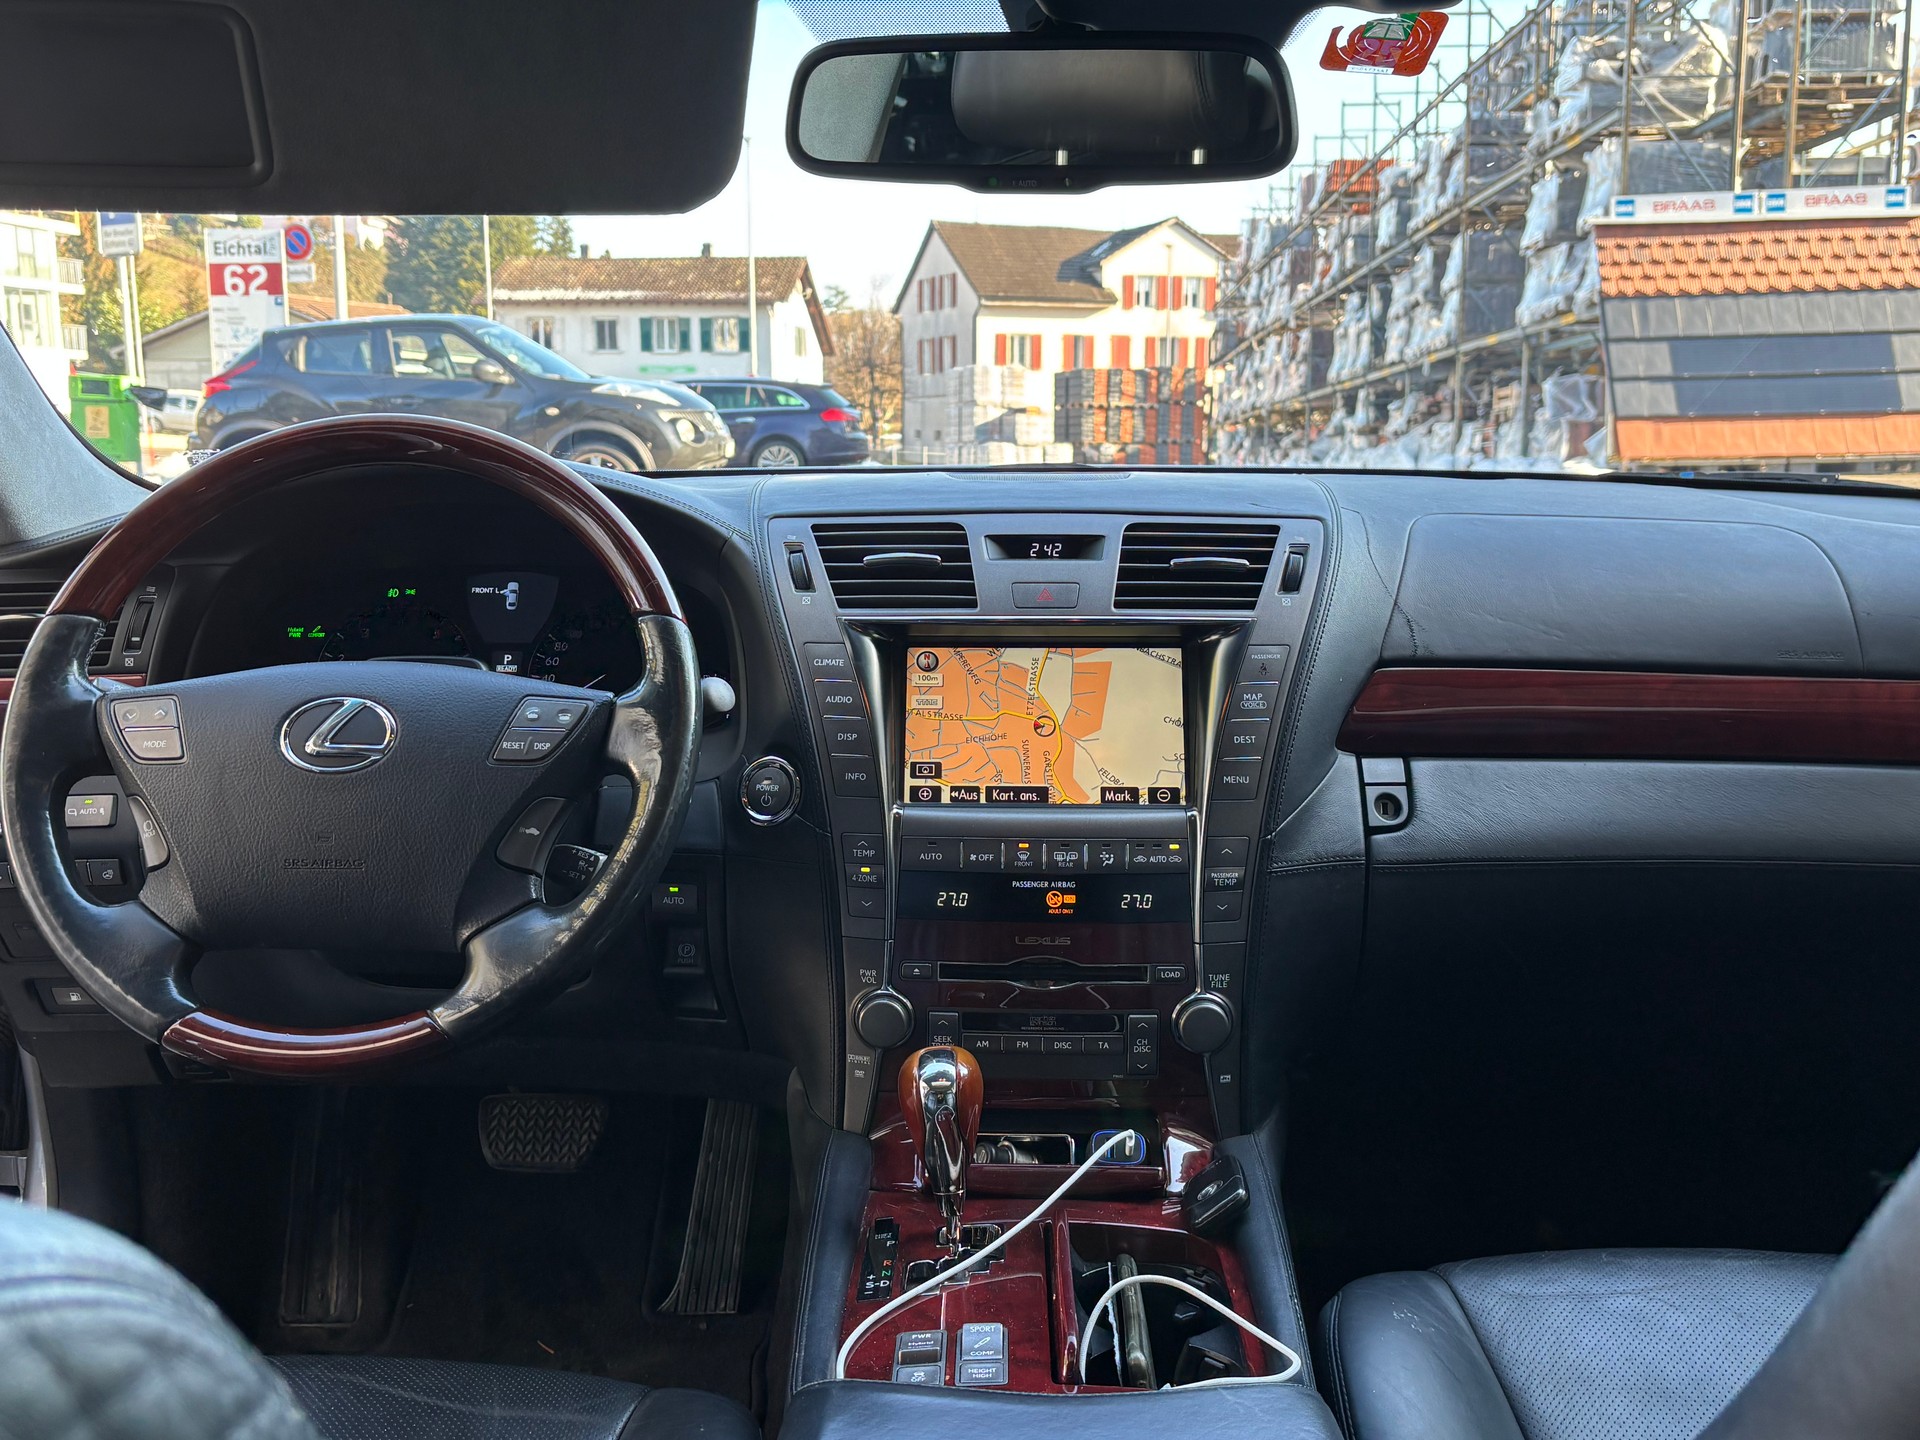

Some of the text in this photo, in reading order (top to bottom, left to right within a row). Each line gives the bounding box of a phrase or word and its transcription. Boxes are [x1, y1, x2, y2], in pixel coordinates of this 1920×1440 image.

[214, 240, 267, 256] Eichtal
[224, 265, 268, 296] 62
[503, 654, 512, 665] P
[545, 657, 560, 666] 60
[813, 658, 845, 667] CLIMATE
[917, 674, 939, 682] 100m
[1026, 657, 1040, 716] ETZELSTRASSE
[825, 695, 853, 704] AUDIO
[1243, 692, 1263, 701] MAP
[1243, 701, 1264, 709] VOICE
[837, 733, 858, 741] DISP
[1233, 735, 1256, 744] DEST
[143, 740, 167, 748] MODE
[502, 741, 551, 750] RESET DISP
[845, 772, 867, 781] INFO
[1223, 775, 1249, 784] MENU
[755, 784, 779, 792] POWER
[958, 789, 978, 801] Aus
[992, 788, 1040, 801] Kart. ans.
[1105, 789, 1134, 802] Mark.
[79, 807, 98, 815] AUTO
[852, 849, 876, 858] TEMP
[919, 852, 943, 861] AUTO
[978, 853, 995, 862] OFF
[1149, 855, 1167, 863] AUTO
[1012, 880, 1049, 888] PASSENGER
[1213, 878, 1237, 886] TEMP
[662, 896, 685, 905] AUTO
[937, 891, 969, 907] 27.0
[1121, 894, 1153, 909] 27.0
[1015, 936, 1071, 946] LEXUS
[859, 968, 877, 977] PWR
[1208, 973, 1230, 981] TUNE
[861, 976, 877, 984] VOL
[976, 1040, 989, 1048] AM
[1016, 1041, 1029, 1049] FM
[1098, 1041, 1110, 1049] TA
[1136, 1038, 1148, 1046] CH
[1133, 1045, 1151, 1053] DISC
[881, 1269, 891, 1277] N
[969, 1325, 996, 1333] SPORT
